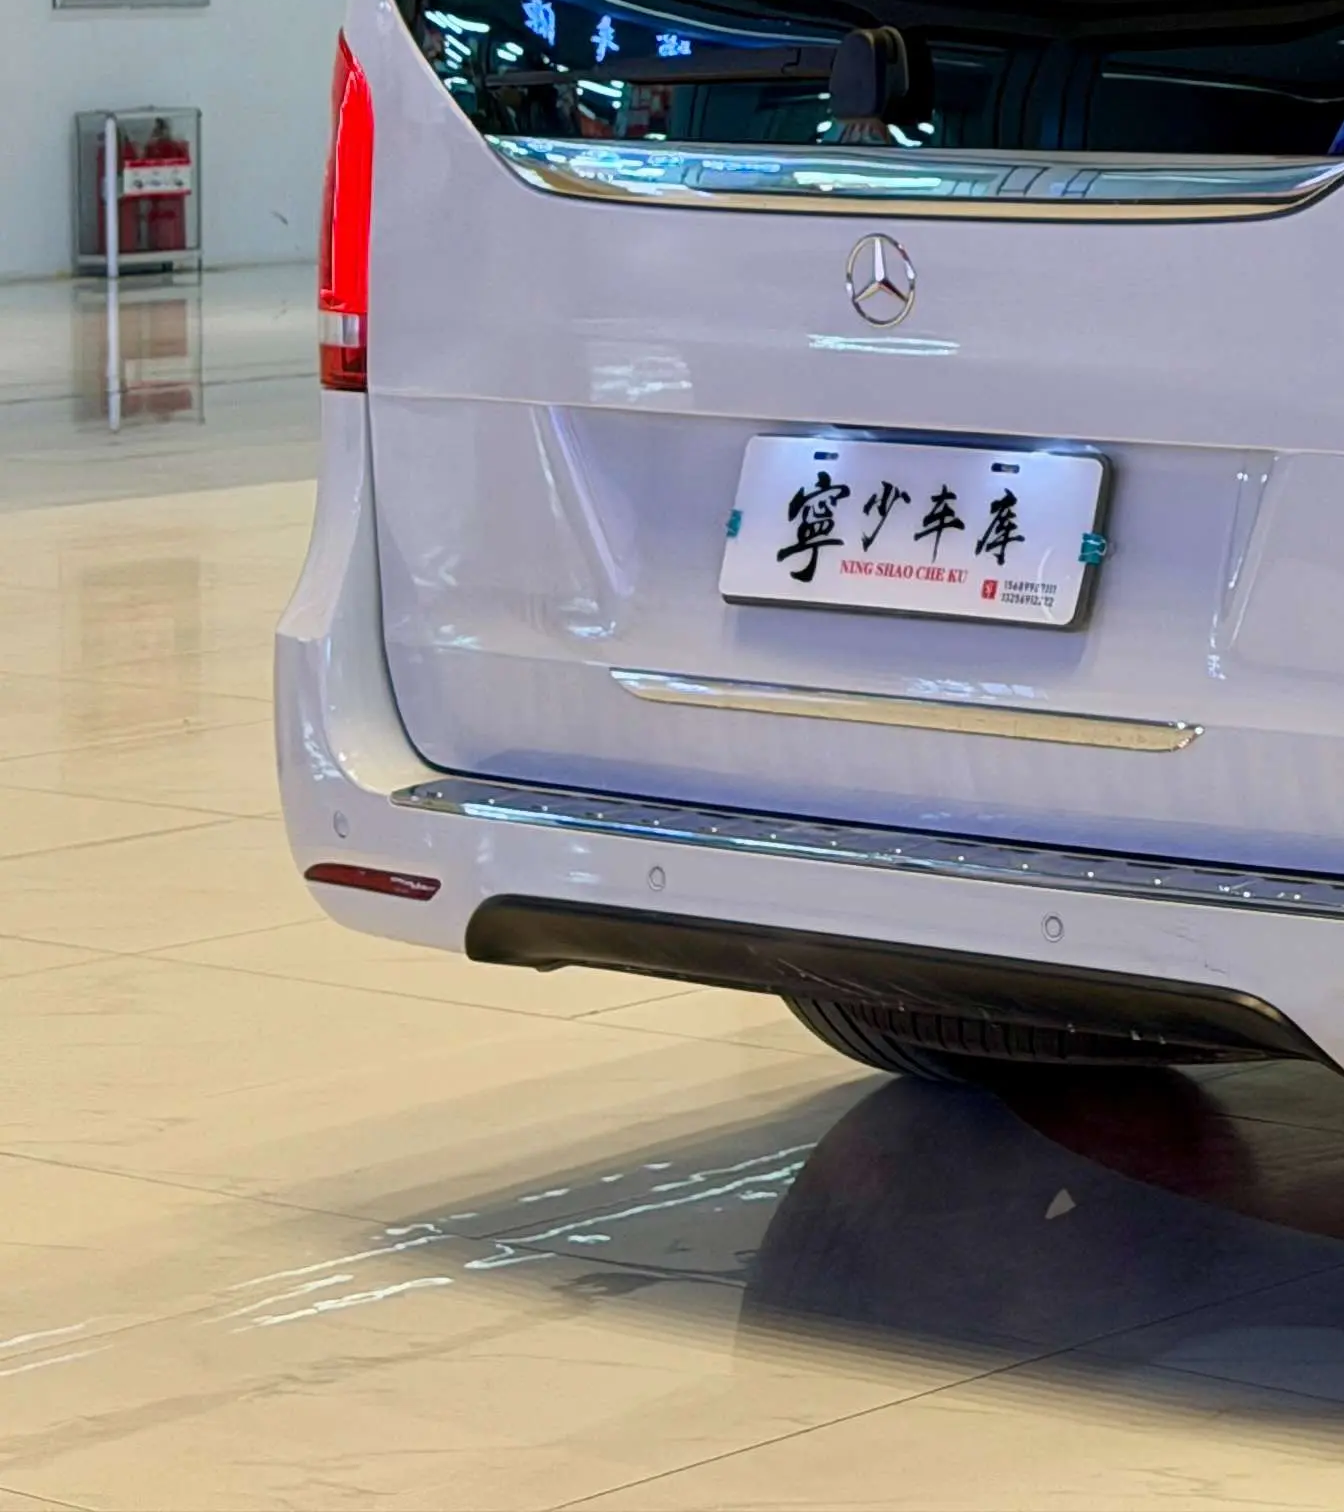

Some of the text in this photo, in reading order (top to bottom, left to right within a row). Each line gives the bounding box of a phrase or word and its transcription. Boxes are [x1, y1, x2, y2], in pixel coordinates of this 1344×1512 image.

[839, 559, 969, 584] NING SHAO CHE KU
